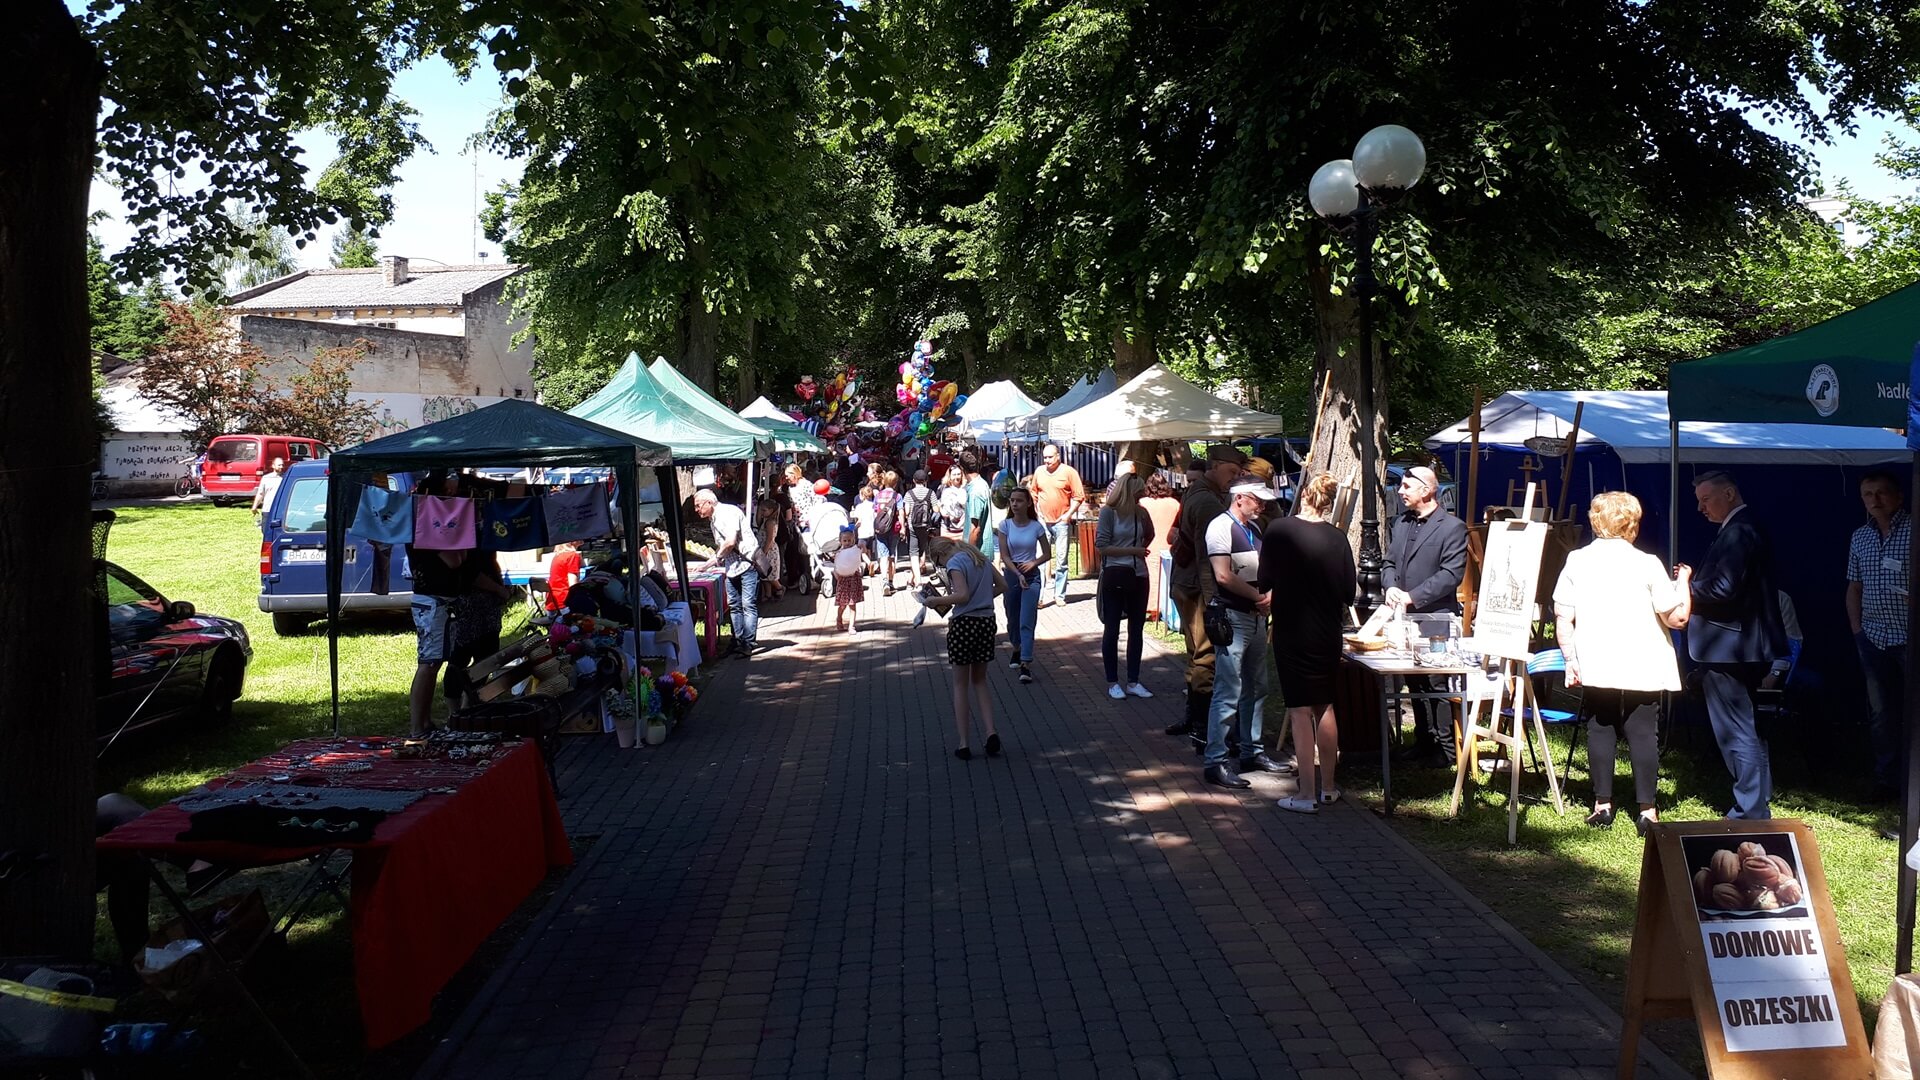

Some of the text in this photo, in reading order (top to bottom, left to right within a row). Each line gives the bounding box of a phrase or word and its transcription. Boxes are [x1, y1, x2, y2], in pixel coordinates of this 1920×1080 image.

[289, 551, 308, 560] BHA
[1708, 929, 1818, 958] DOMOWE
[1723, 995, 1834, 1027] ORZESZKI
